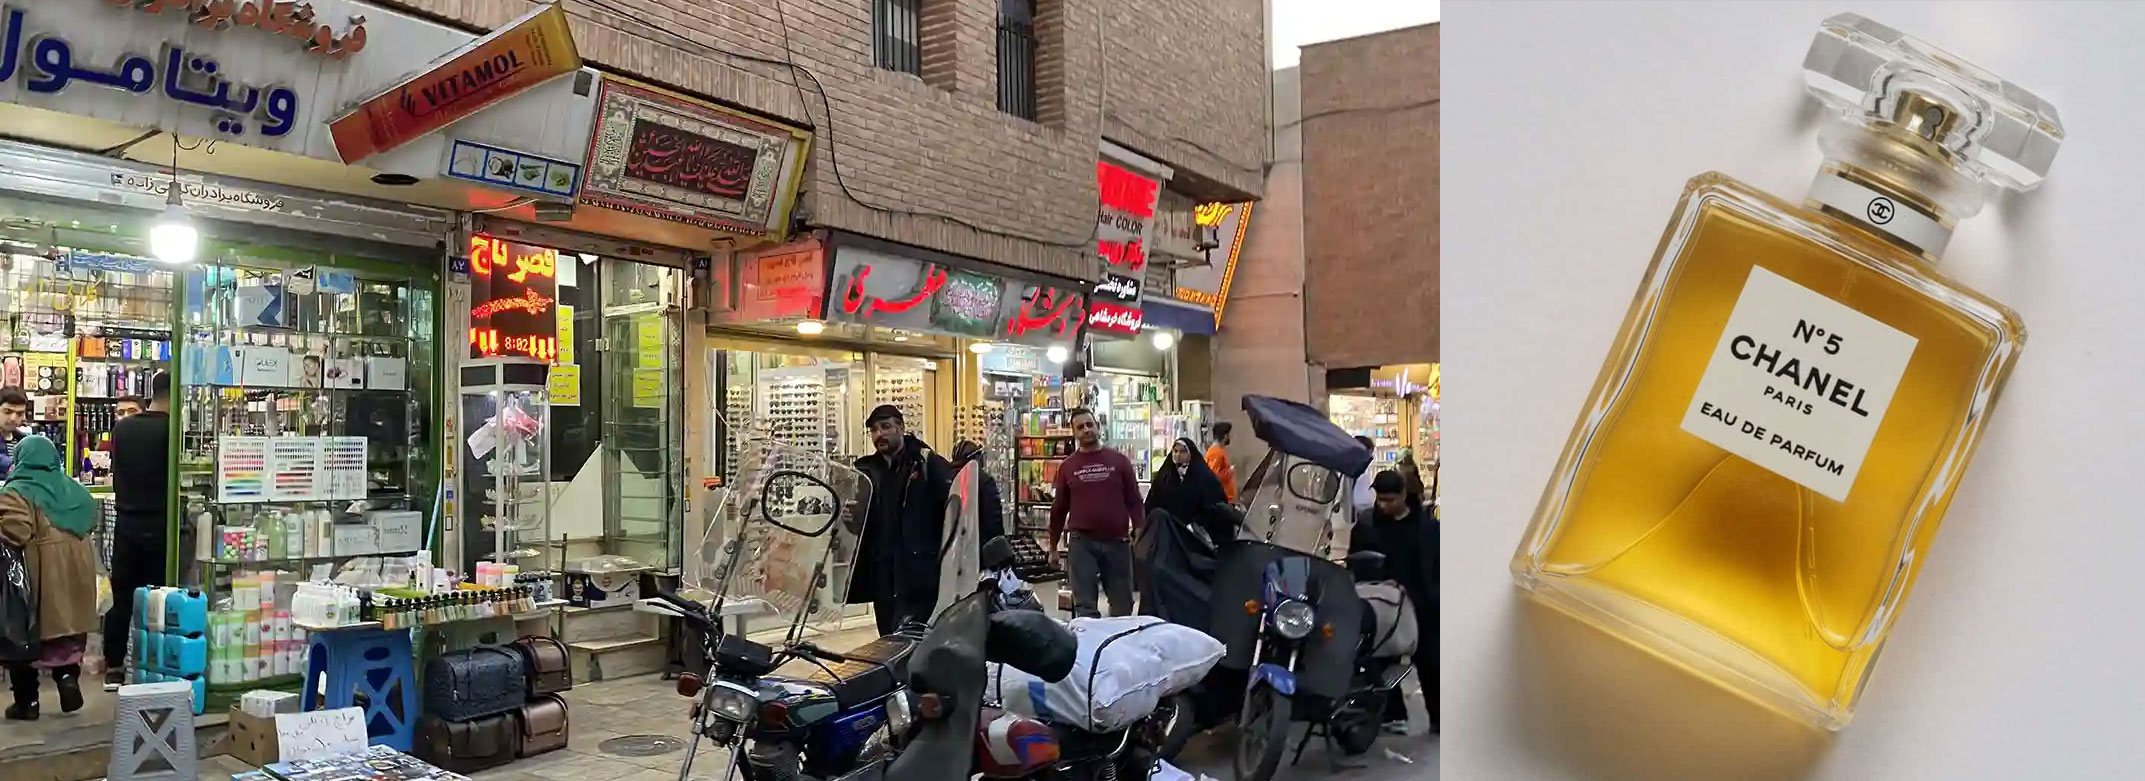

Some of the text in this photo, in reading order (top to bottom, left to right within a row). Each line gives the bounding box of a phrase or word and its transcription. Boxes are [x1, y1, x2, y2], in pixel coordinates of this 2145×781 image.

[421, 49, 526, 107] VITAMOL
[233, 191, 284, 210] فروشگاه
[1115, 214, 1143, 236] COLOR
[507, 248, 555, 284] قصر
[1730, 335, 1869, 418] CHANEL
[1763, 385, 1814, 415] PARIS
[1700, 401, 1845, 476] EAU DE PARFUM
